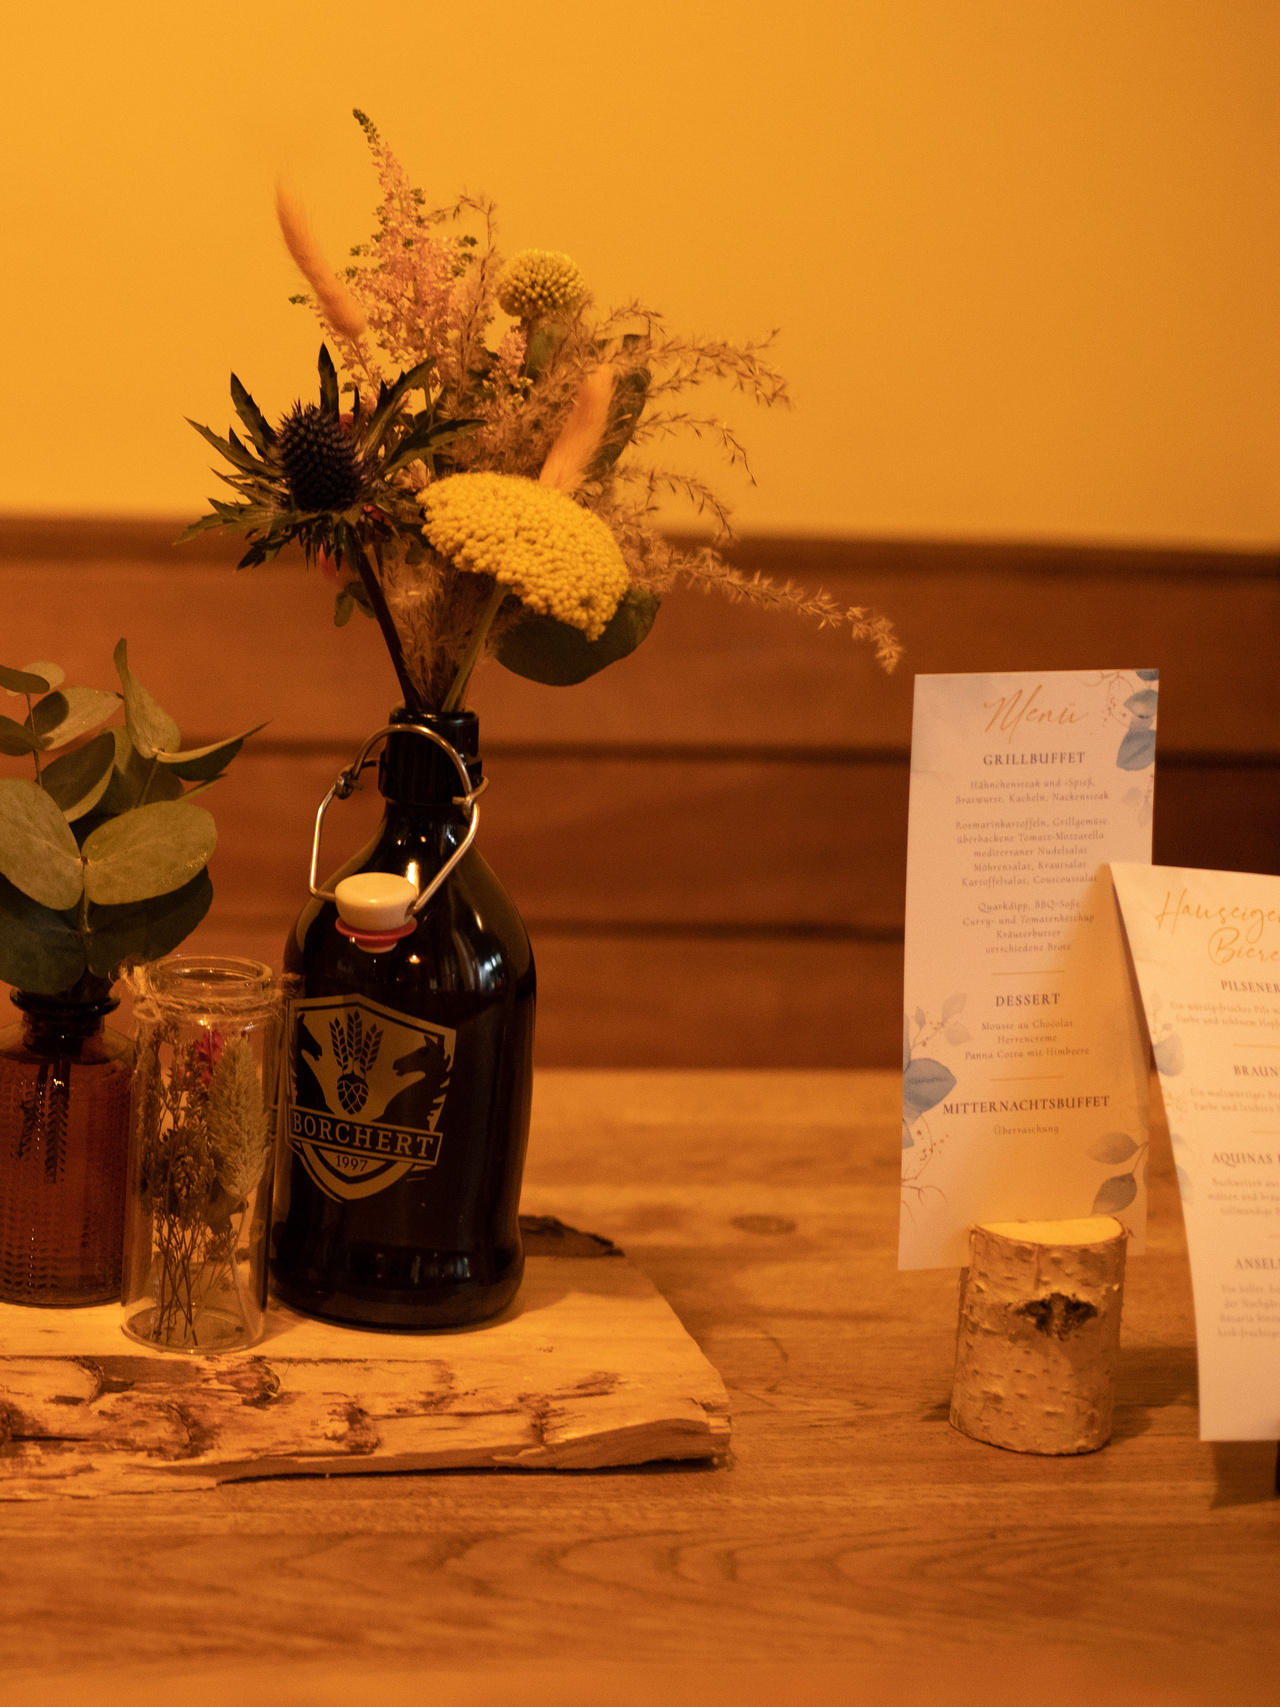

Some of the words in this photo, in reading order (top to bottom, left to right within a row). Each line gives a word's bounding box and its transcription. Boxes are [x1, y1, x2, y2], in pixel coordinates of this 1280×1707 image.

[983, 684, 1089, 744] Menü
[983, 751, 1085, 766] GRILLBUFFET
[970, 778, 1041, 790] Hähnchensteak
[1044, 778, 1061, 788] und
[956, 794, 1005, 804] Bratwurst,
[1053, 790, 1109, 801] Nackensteak
[956, 817, 1049, 830] Rosmarinkartoffeln,
[1052, 816, 1108, 829] Grillgemüse
[957, 834, 1014, 844] überbackene
[973, 846, 1034, 858] mediterraner
[1038, 845, 1087, 856] Nudelsalat
[973, 861, 1034, 872] Möhrensalat,
[1038, 859, 1086, 870] Krautsalat
[962, 875, 1030, 888] Kartoffelsalat,
[1033, 872, 1097, 884] Couscoussalat
[1035, 898, 1080, 911] BBQ-Soße
[999, 914, 1016, 924] und
[1021, 912, 1095, 924] Tomatenketchup
[996, 928, 1061, 939] Kräuterbutter
[985, 943, 1044, 953] verschiedene
[1048, 942, 1072, 951] Brote
[995, 993, 1061, 1007] DESSERT
[982, 1022, 1015, 1031] Mousse
[1032, 1017, 1073, 1028] Chocolat
[997, 1035, 1057, 1044] Herrencreme
[965, 1051, 993, 1060] Panna
[996, 1050, 1023, 1059] Cotta
[1027, 1049, 1043, 1057] mit
[1046, 1046, 1090, 1057] Himbeere
[1233, 1065, 1280, 1077] BRAUN
[943, 1095, 1110, 1115] MITTERNACHTSBUFFET
[292, 1110, 434, 1158] BORCHERT
[994, 1124, 1059, 1135] Überraschung
[336, 1155, 368, 1171] 1997
[1212, 1152, 1273, 1168] AQUINAS
[1236, 1257, 1280, 1270] ANSEL
